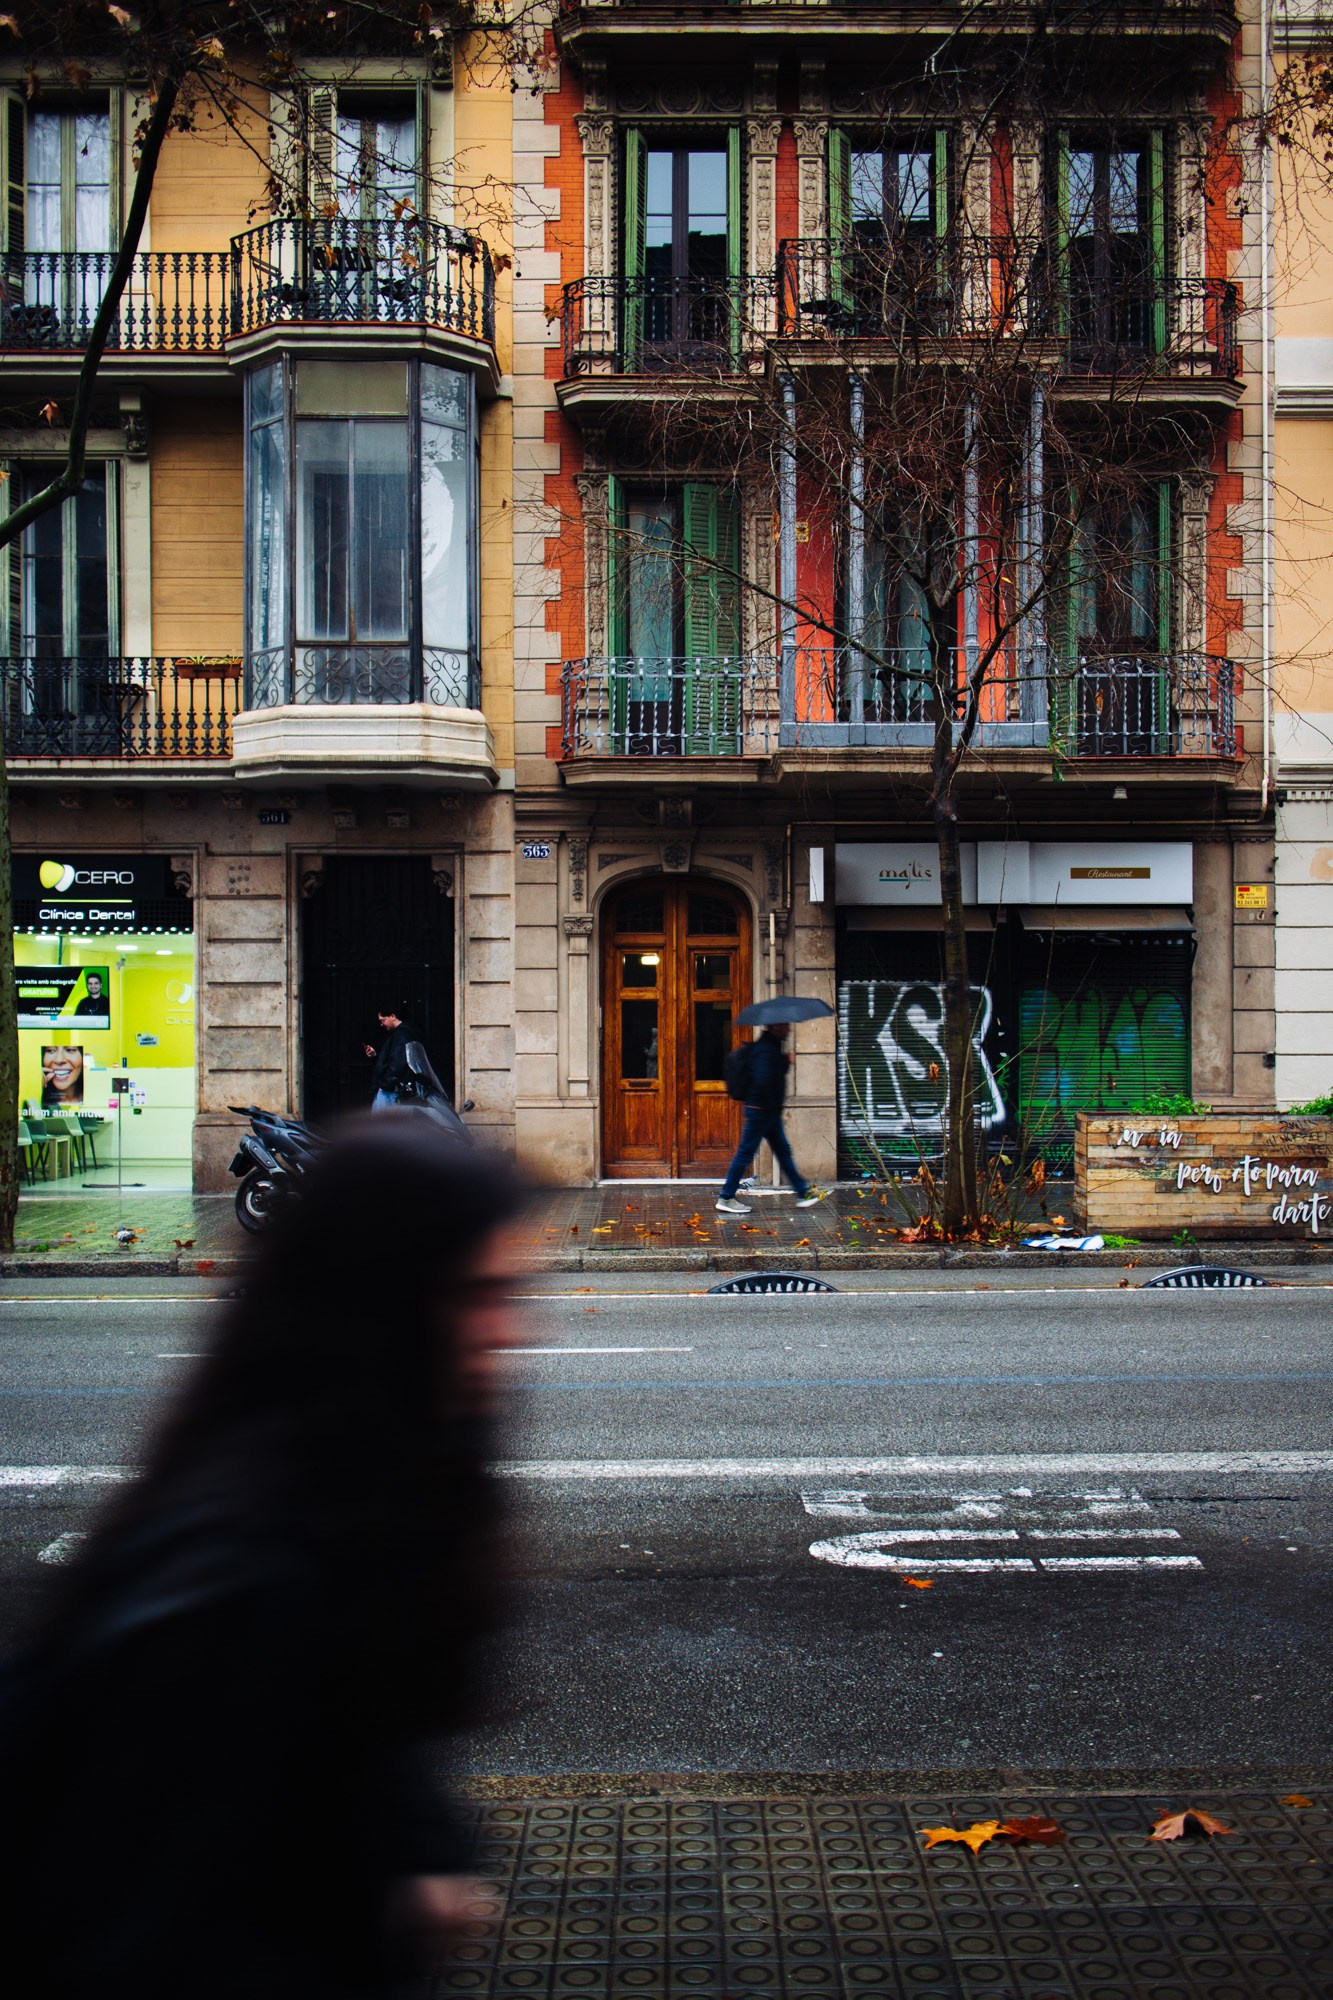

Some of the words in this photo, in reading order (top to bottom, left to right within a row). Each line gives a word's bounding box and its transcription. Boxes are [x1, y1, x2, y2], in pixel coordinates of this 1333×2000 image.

[75, 871, 134, 884] CERO
[879, 860, 932, 890] majlis
[1087, 869, 1134, 879] Restaurant
[39, 909, 84, 920] Clínica
[89, 910, 135, 920] Dental
[52, 1107, 75, 1117] amb
[1272, 1193, 1332, 1234] darte
